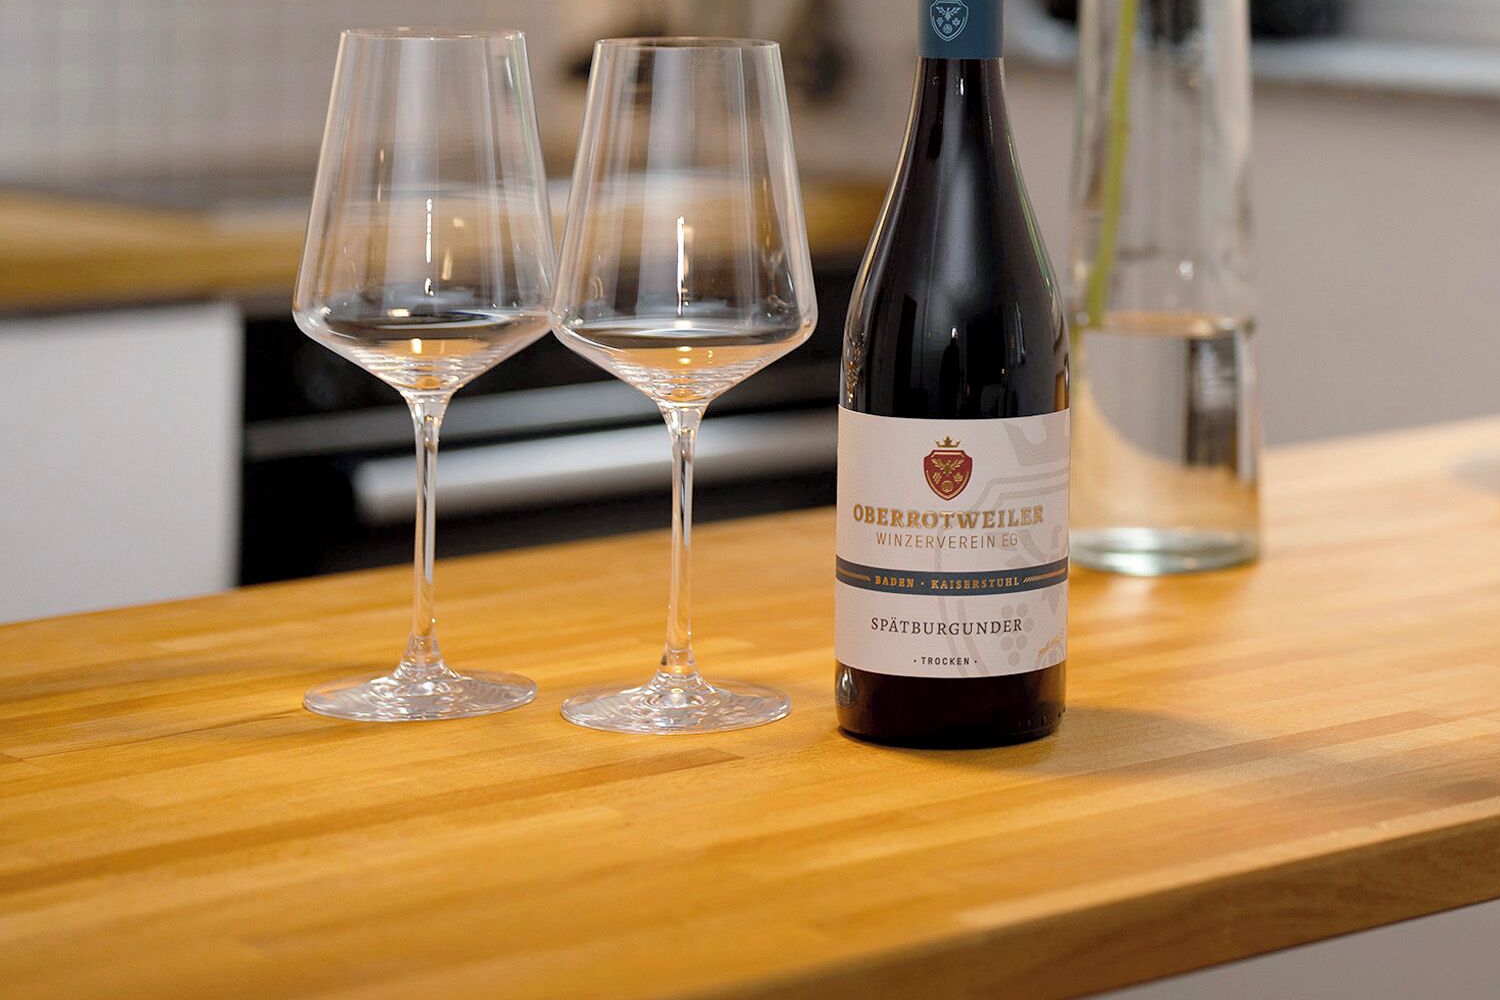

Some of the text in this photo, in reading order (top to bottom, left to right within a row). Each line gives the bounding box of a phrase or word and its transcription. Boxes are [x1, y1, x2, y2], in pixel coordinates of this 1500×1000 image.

[853, 503, 1045, 530] OBERROTWEILER
[876, 532, 996, 549] WINZERVEREIN
[875, 575, 1020, 590] BADEN KAISERSTUHL
[870, 616, 1023, 636] SPÄTBURGUNDER
